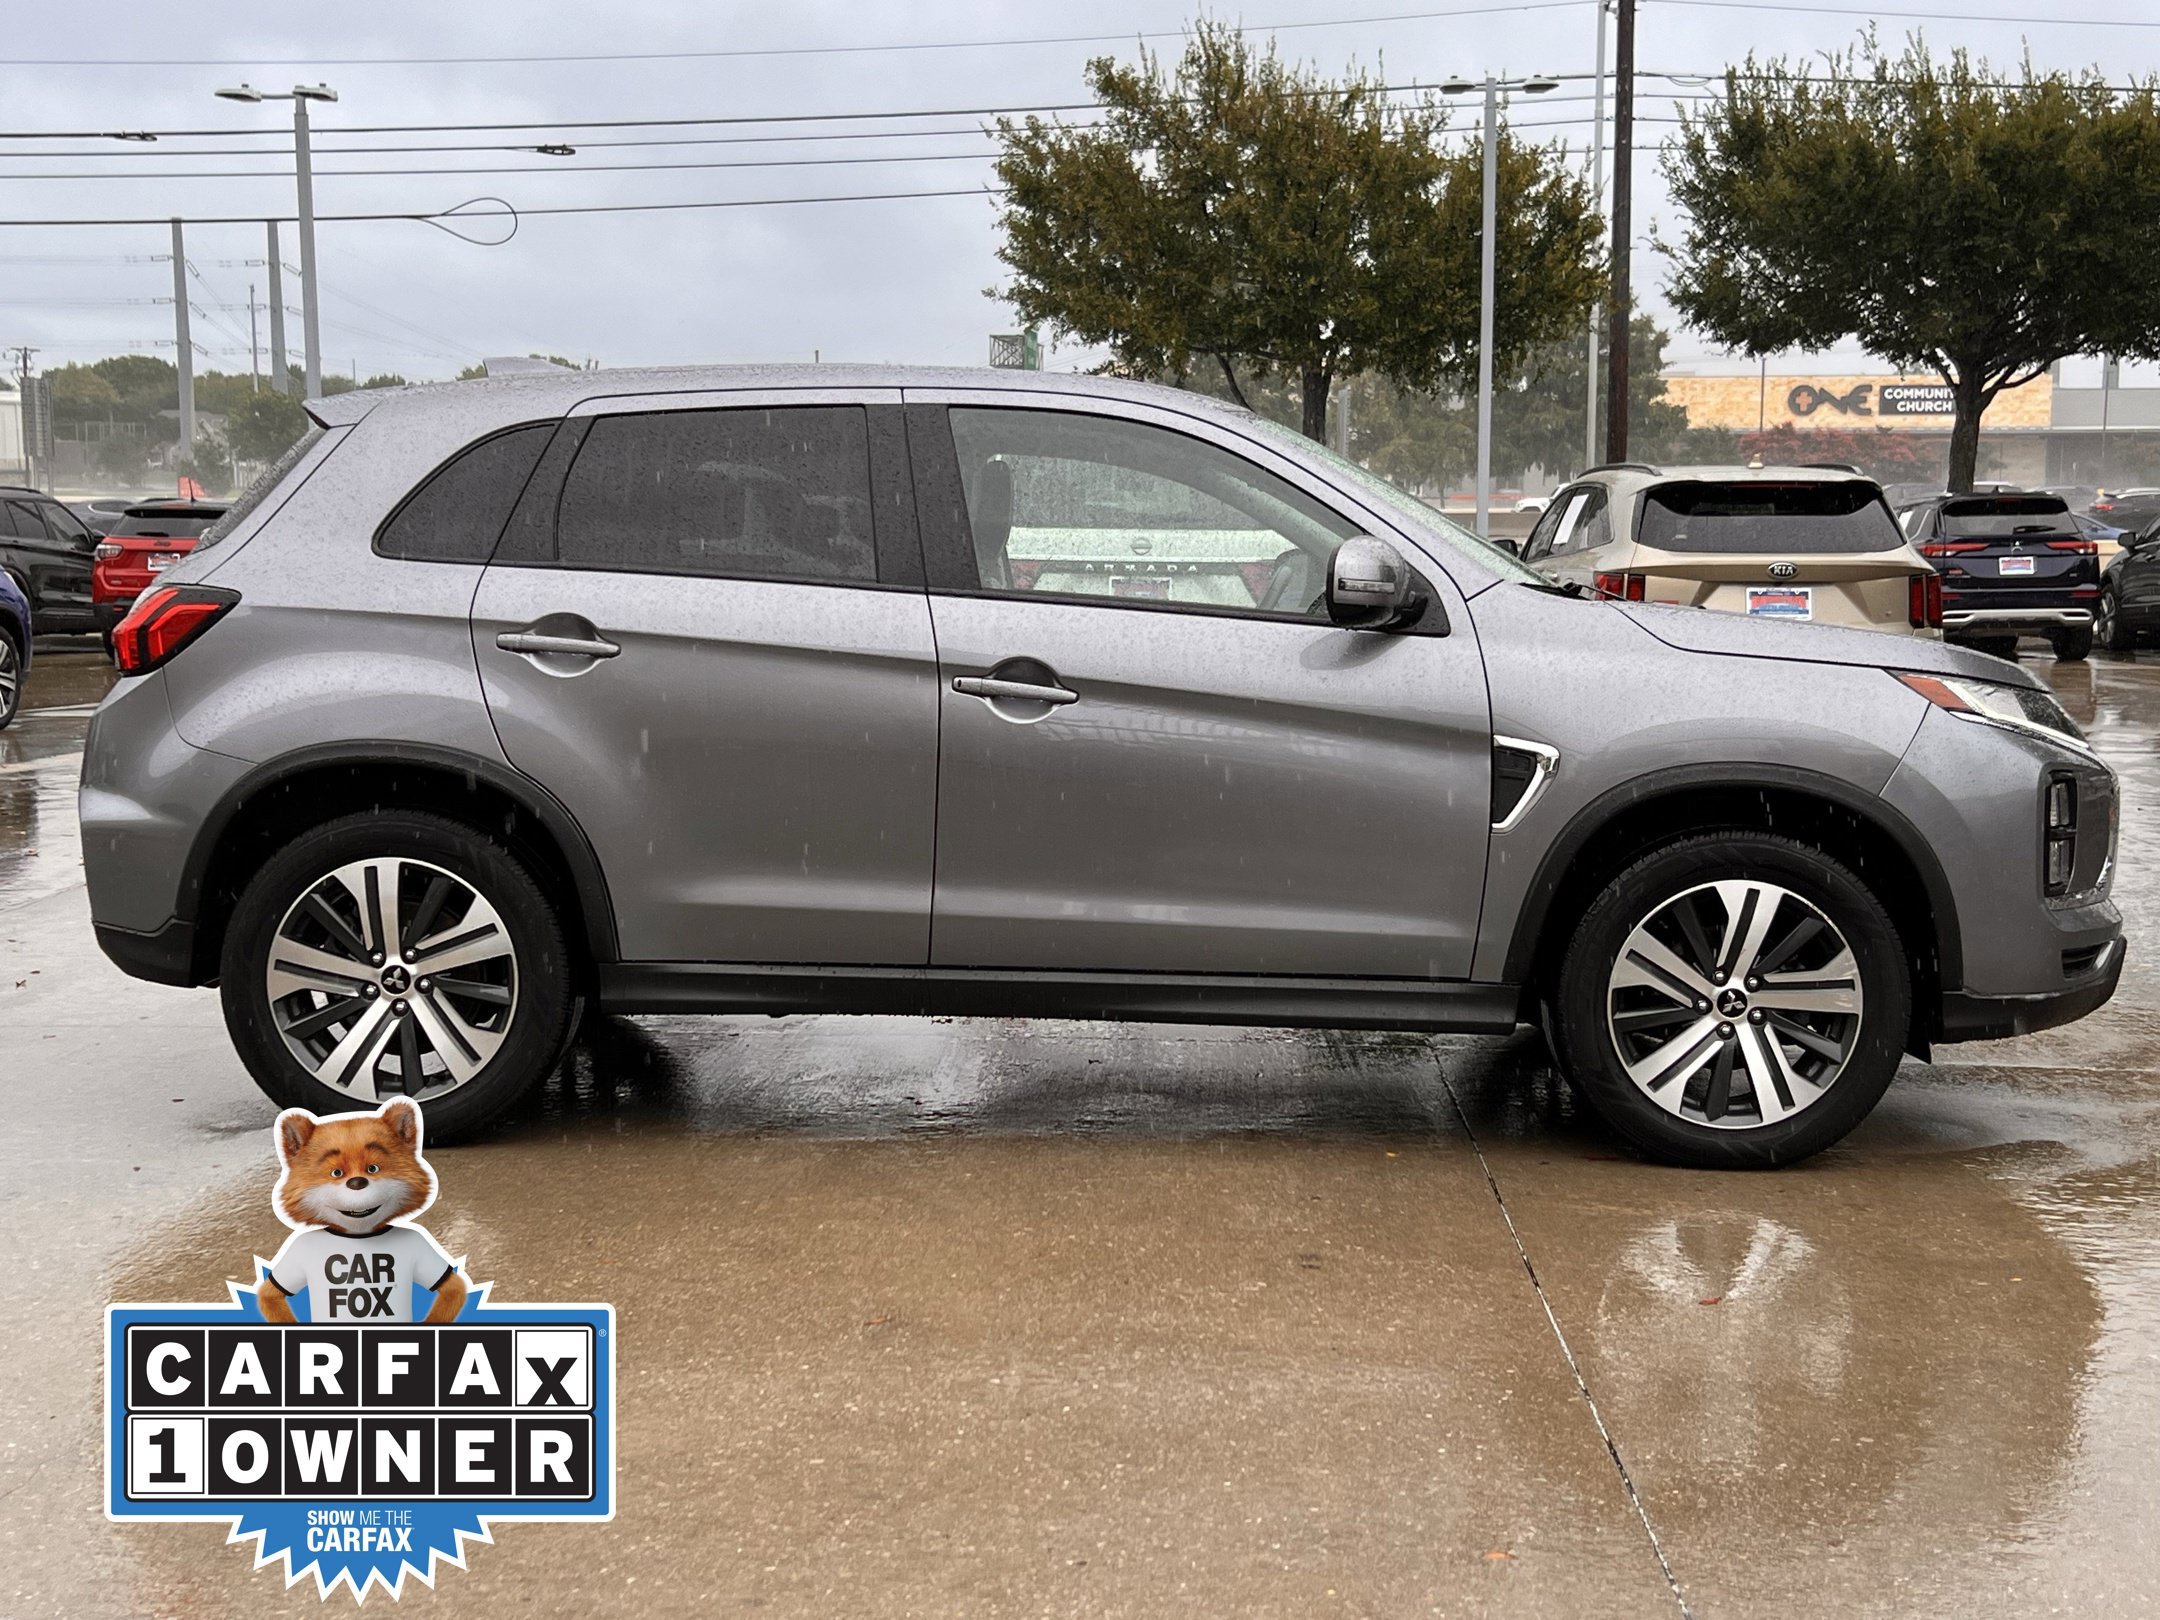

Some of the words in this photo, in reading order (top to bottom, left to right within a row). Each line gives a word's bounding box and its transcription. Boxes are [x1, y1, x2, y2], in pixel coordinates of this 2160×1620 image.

[1884, 388, 1954, 399] COMMUNIT
[1788, 384, 1872, 416] ONE
[1897, 401, 1953, 412] CHURCH
[1085, 563, 1198, 573] ARMADA
[1773, 565, 1794, 575] KIA
